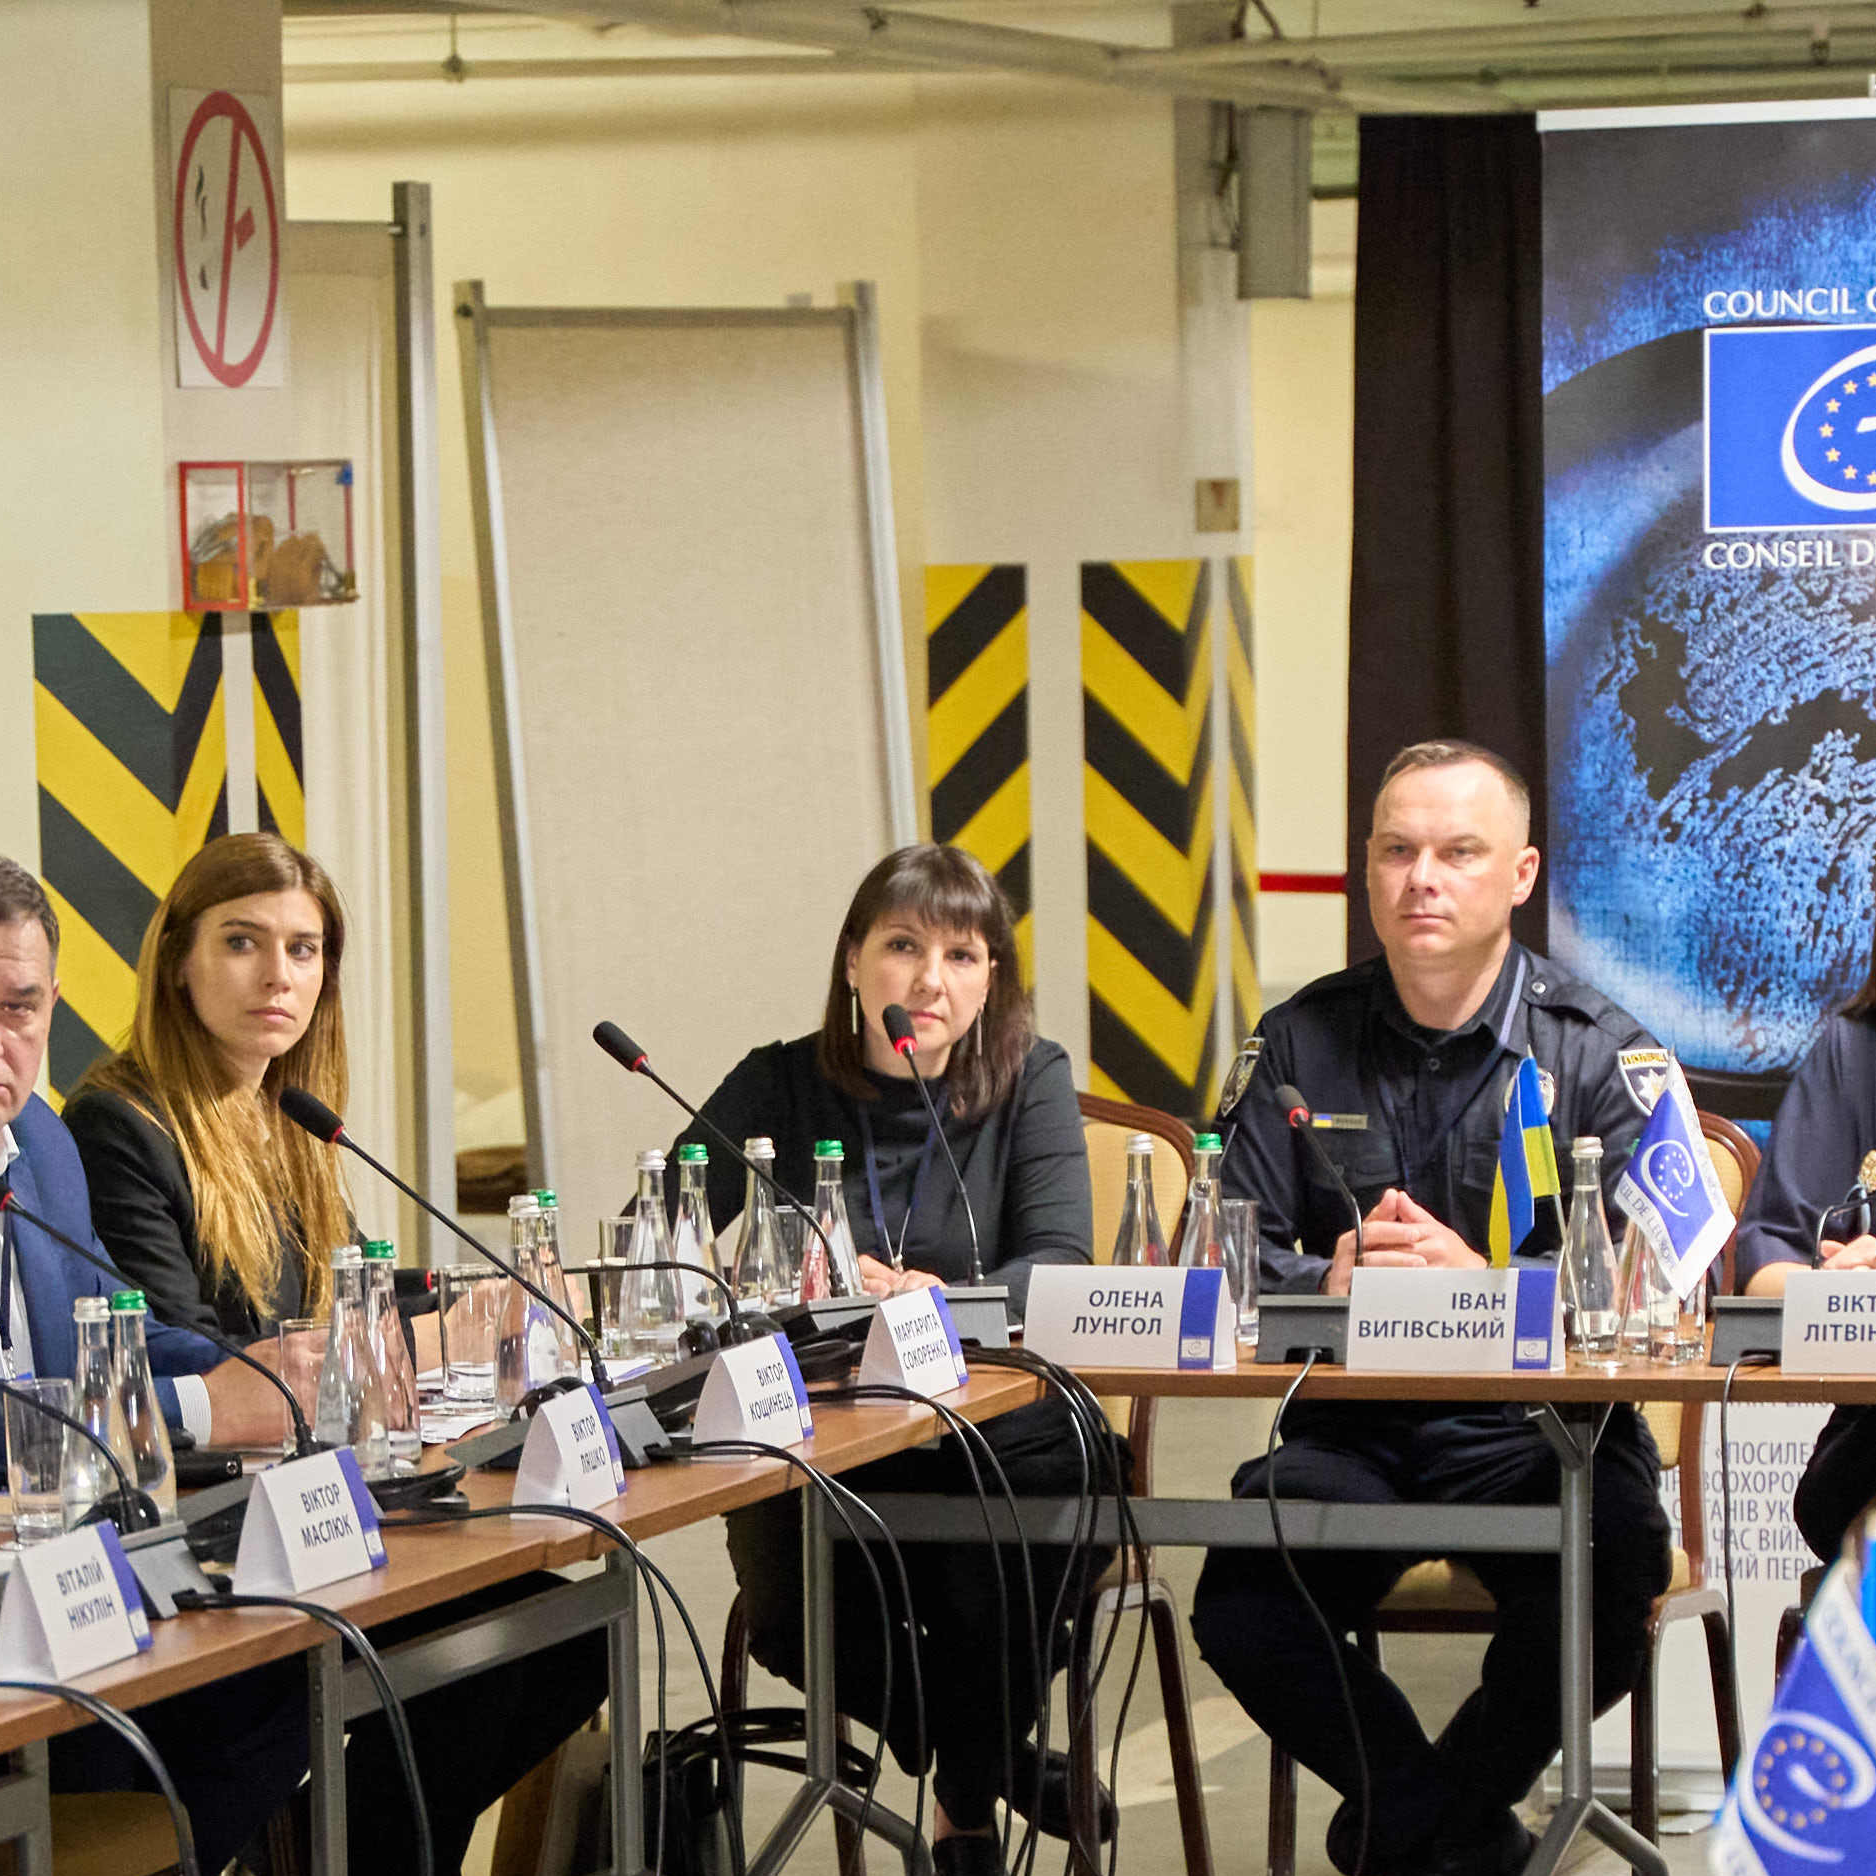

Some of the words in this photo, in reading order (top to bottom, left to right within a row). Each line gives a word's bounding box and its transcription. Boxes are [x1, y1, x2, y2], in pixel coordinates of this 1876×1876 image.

[1703, 286, 1857, 319] COUNCIL
[1703, 539, 1842, 570] CONSEIL
[1088, 1289, 1164, 1308] ОЛЕНА
[1451, 1292, 1507, 1311] ІВАН
[894, 1312, 940, 1343] МАРГАРИТА
[1071, 1316, 1162, 1336] ЛУНГОЛ
[1357, 1316, 1505, 1339] ВИГІВСЬКИЙ
[903, 1338, 948, 1370] СОКОРЕНКО
[756, 1361, 784, 1388] ВІКТОР
[570, 1414, 597, 1442] ВІКТОР
[300, 1482, 341, 1514] ВІКТОР
[301, 1513, 354, 1548] МАСЛЮК
[56, 1554, 105, 1596] ВІТАЛІЙ
